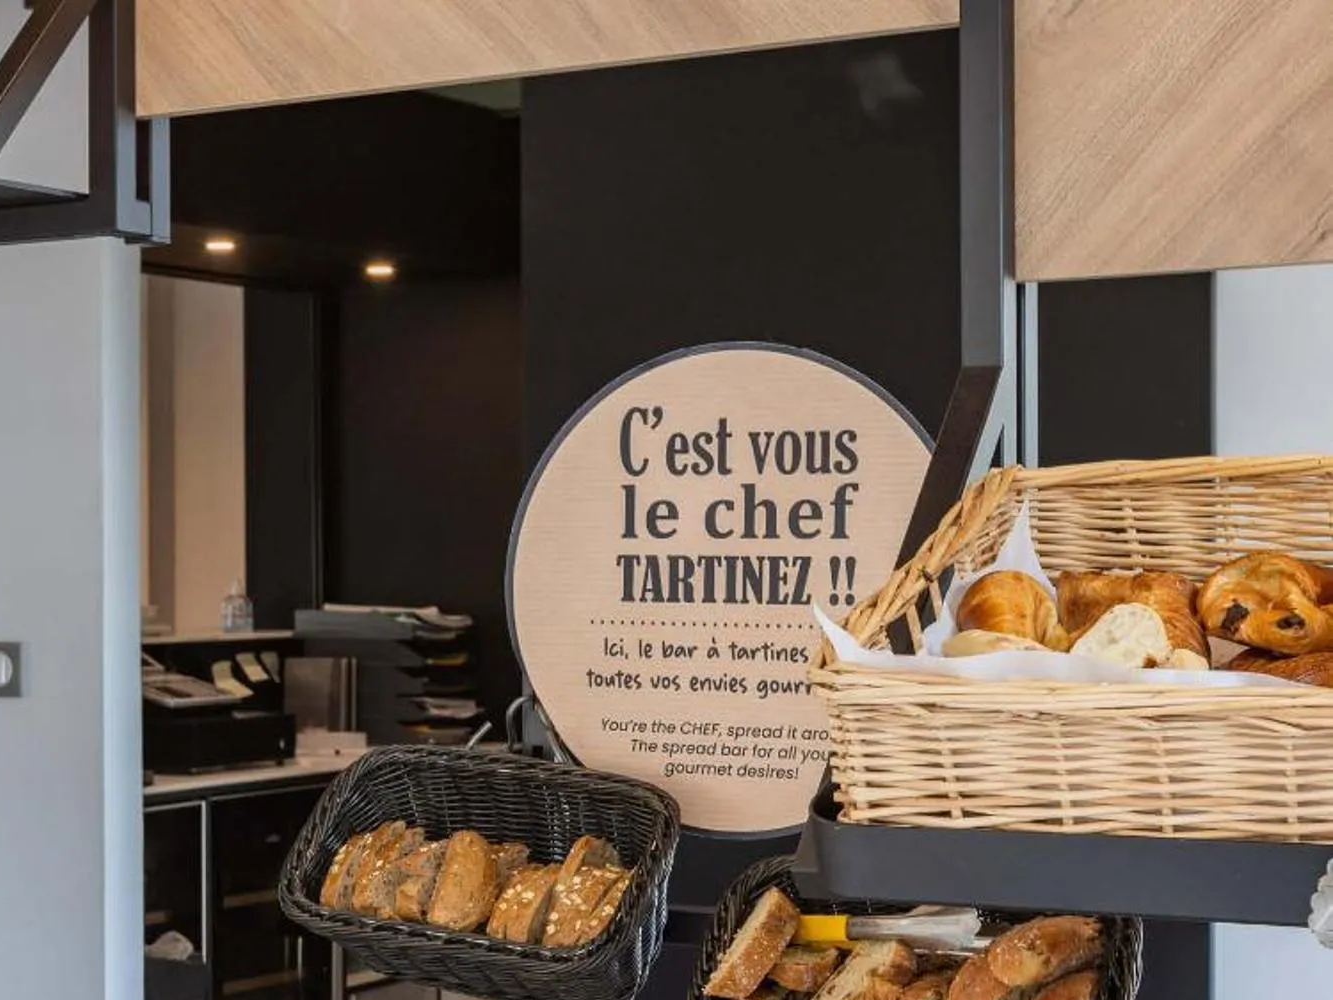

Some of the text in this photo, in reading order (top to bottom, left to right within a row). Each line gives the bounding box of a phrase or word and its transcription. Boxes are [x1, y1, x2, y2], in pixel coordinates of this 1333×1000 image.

[619, 406, 859, 477] C'est vous
[621, 482, 860, 540] le chef
[616, 554, 857, 607] TARTINEZ !!
[603, 636, 810, 663] Ici, le bar à tartines
[586, 668, 643, 690] toutes
[650, 674, 682, 692] vos
[689, 673, 748, 695] envies
[601, 717, 834, 742] You're the CHEF, spread it aro
[631, 738, 659, 754] The
[661, 741, 718, 758] spread
[720, 744, 747, 758] bar
[751, 744, 773, 760] for
[777, 746, 798, 760] all
[664, 761, 800, 781] gourmet desires!
